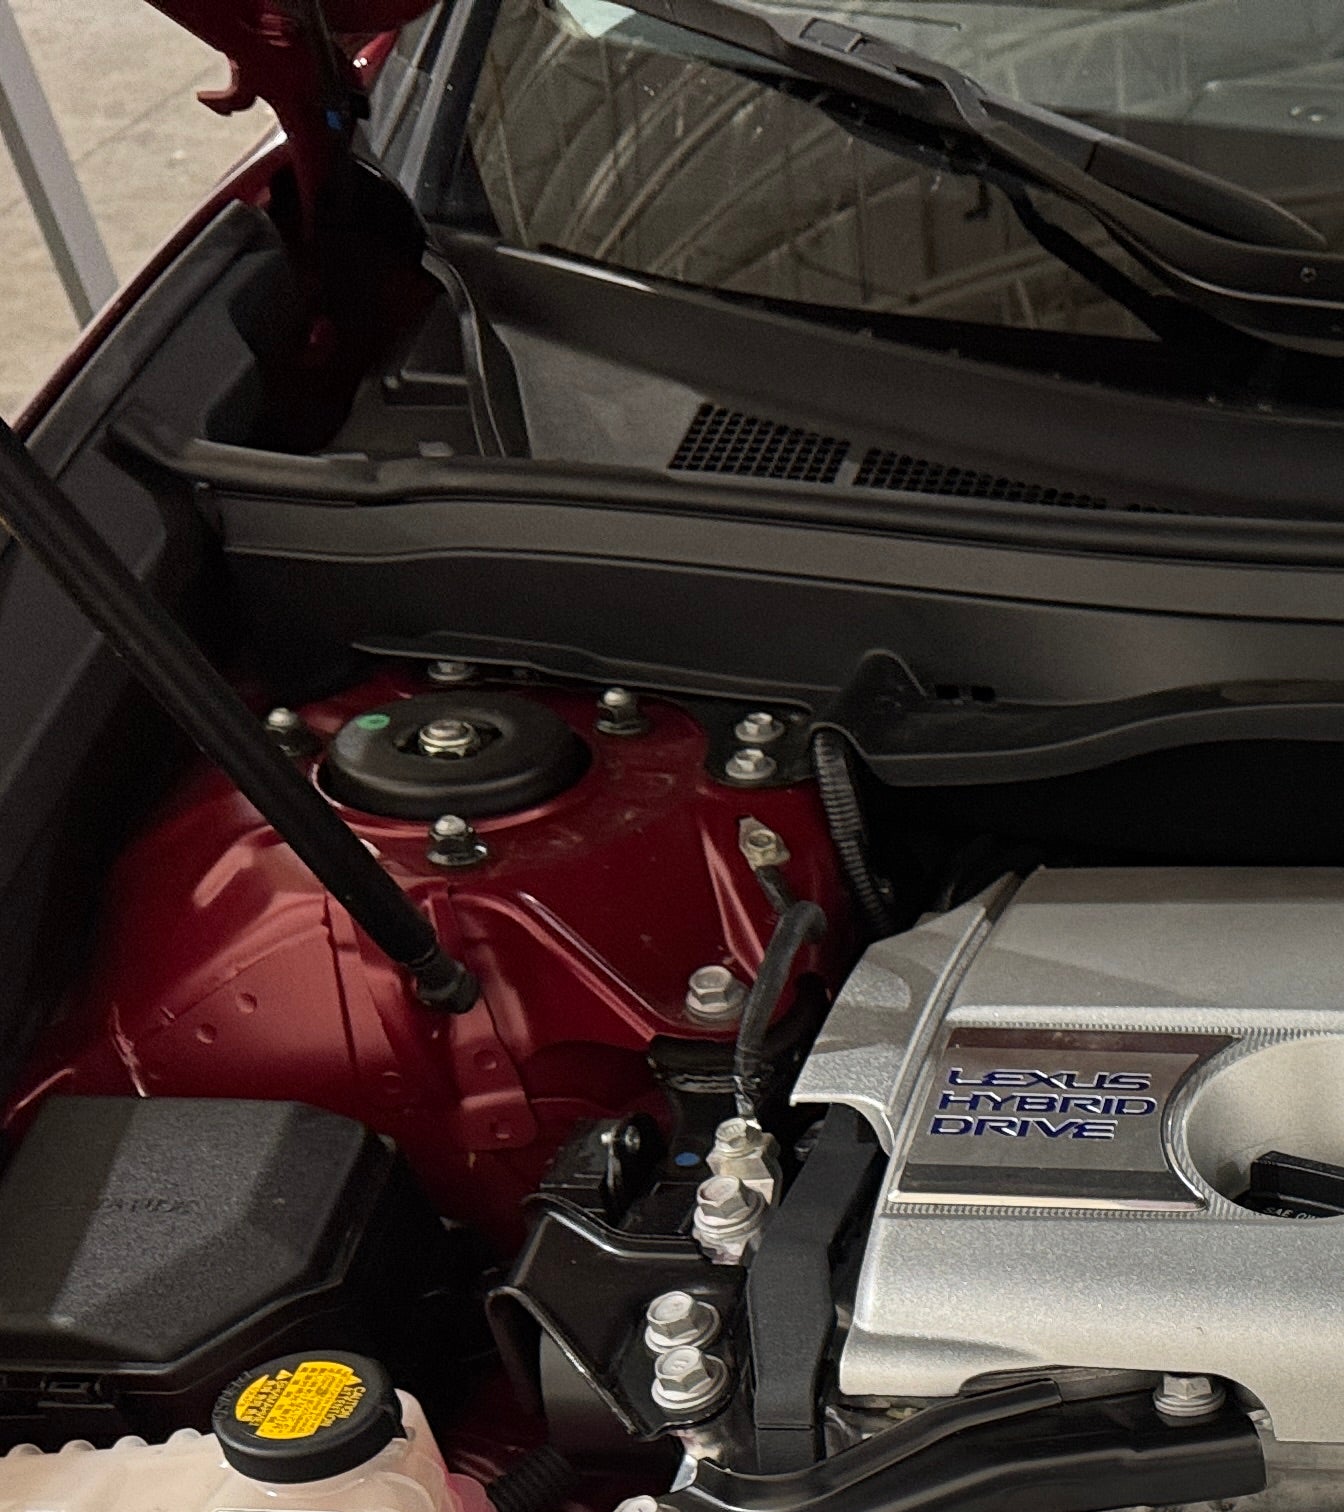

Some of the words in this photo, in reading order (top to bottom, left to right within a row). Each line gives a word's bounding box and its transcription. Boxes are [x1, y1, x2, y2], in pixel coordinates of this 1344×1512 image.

[949, 1067, 1154, 1091] LEXUS
[938, 1090, 1158, 1116] HYBRID
[930, 1115, 1118, 1140] DRIVE
